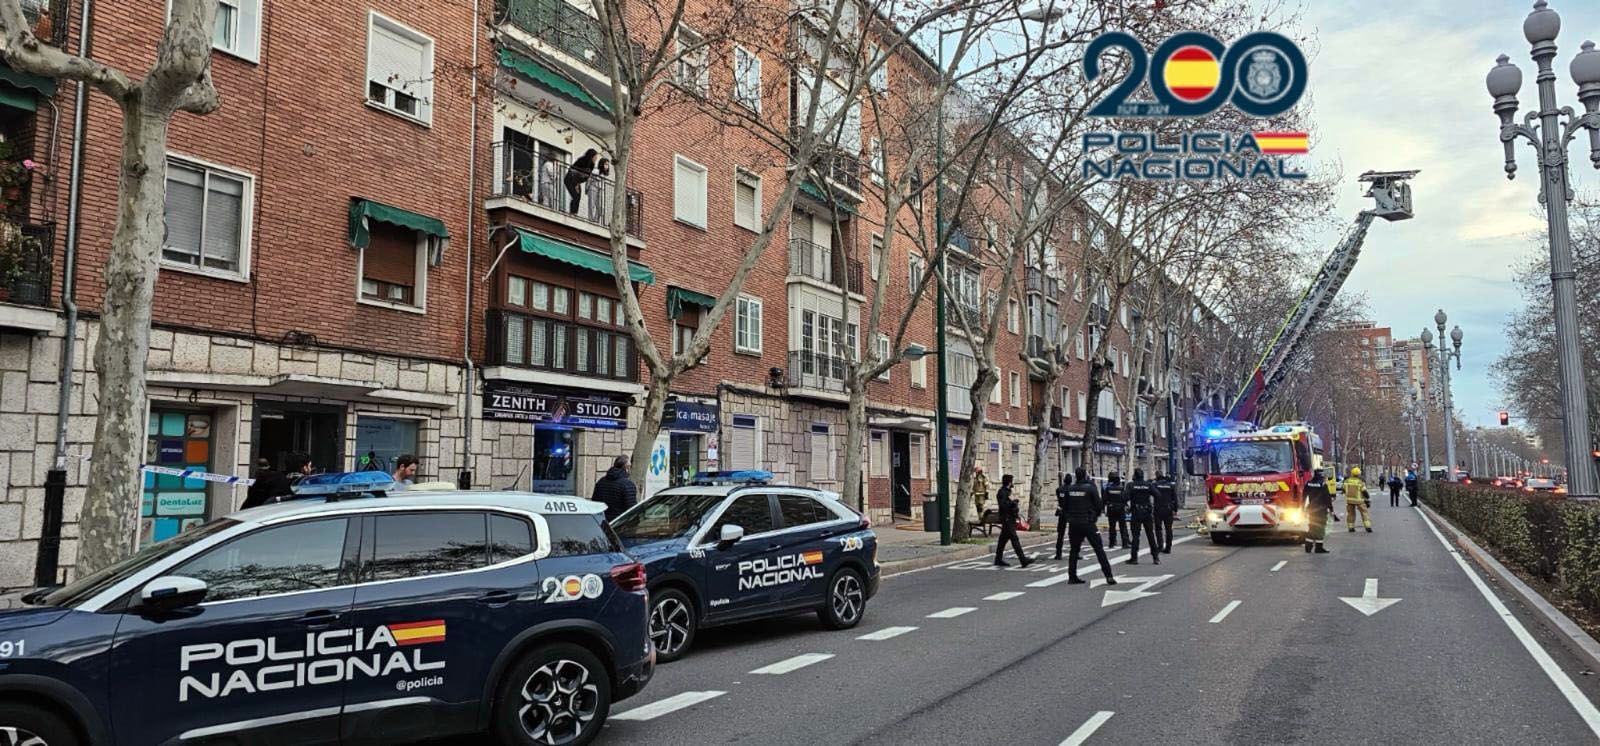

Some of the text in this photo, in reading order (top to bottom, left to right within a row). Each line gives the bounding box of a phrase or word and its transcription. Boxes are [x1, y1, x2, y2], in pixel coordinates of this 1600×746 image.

[492, 394, 621, 417] ZENITH STUDIO
[690, 411, 716, 424] masaje
[544, 501, 578, 512] 4MB
[738, 553, 808, 575] POLICIA
[542, 573, 604, 604] 200
[738, 565, 824, 591] NACIONAL
[180, 624, 397, 671] POLICIA
[179, 649, 446, 702] NACIONAL
[396, 675, 444, 692] @policia
